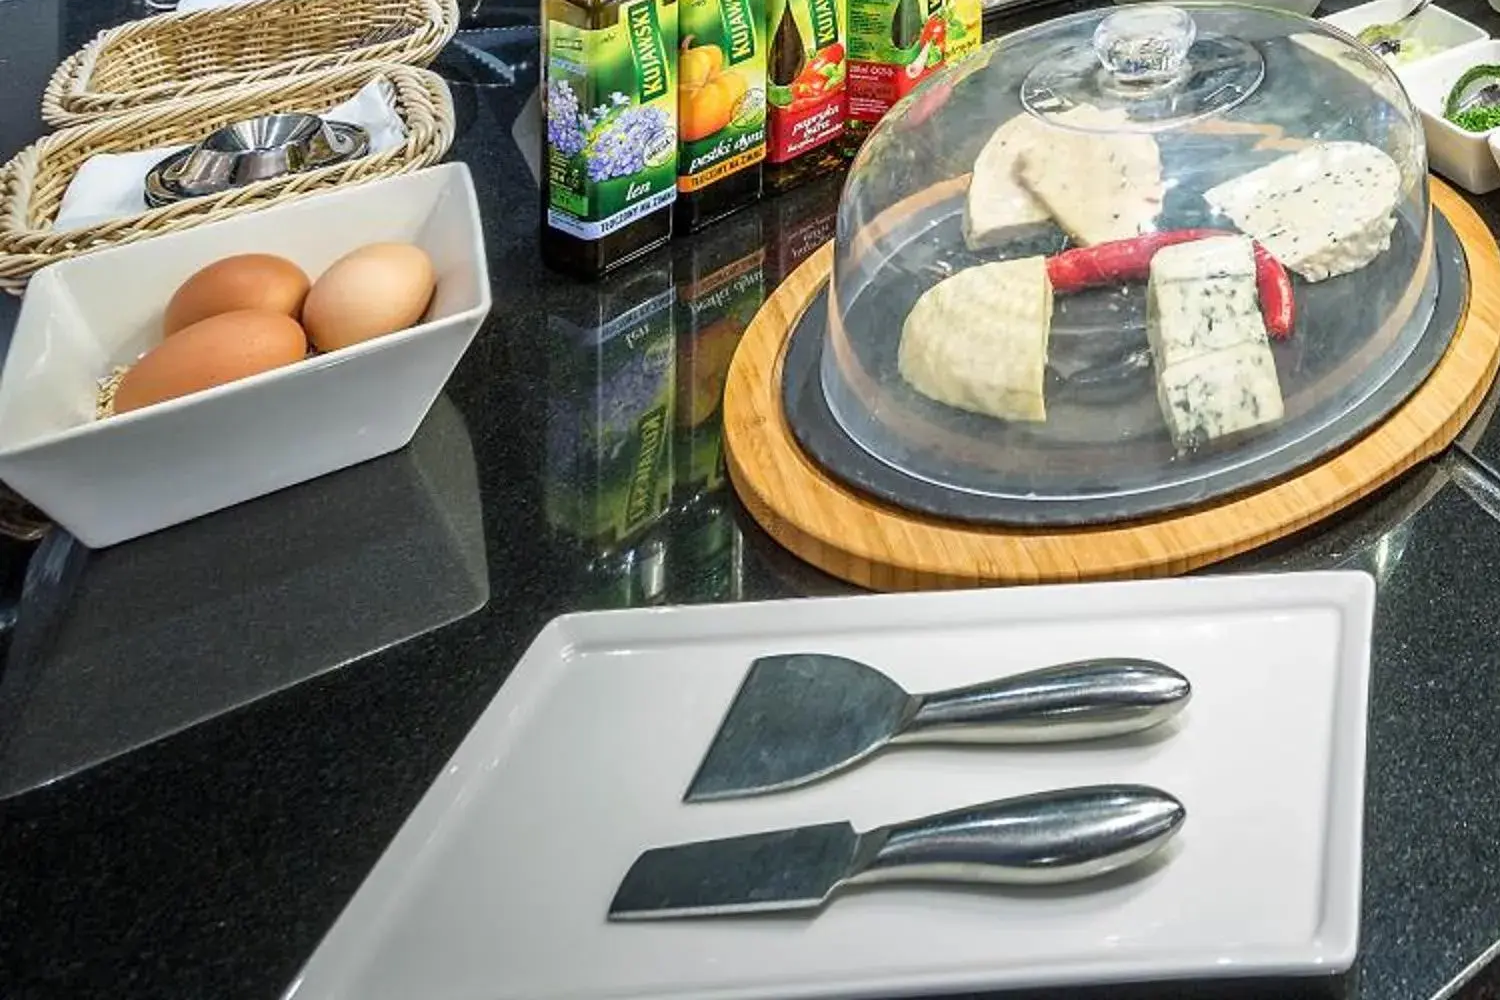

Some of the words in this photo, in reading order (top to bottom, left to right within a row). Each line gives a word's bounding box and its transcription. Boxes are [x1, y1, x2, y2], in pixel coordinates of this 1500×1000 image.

[631, 6, 664, 97] KUJAWSKI
[688, 138, 731, 174] pestki
[733, 123, 765, 151] dyni
[626, 181, 651, 201] len
